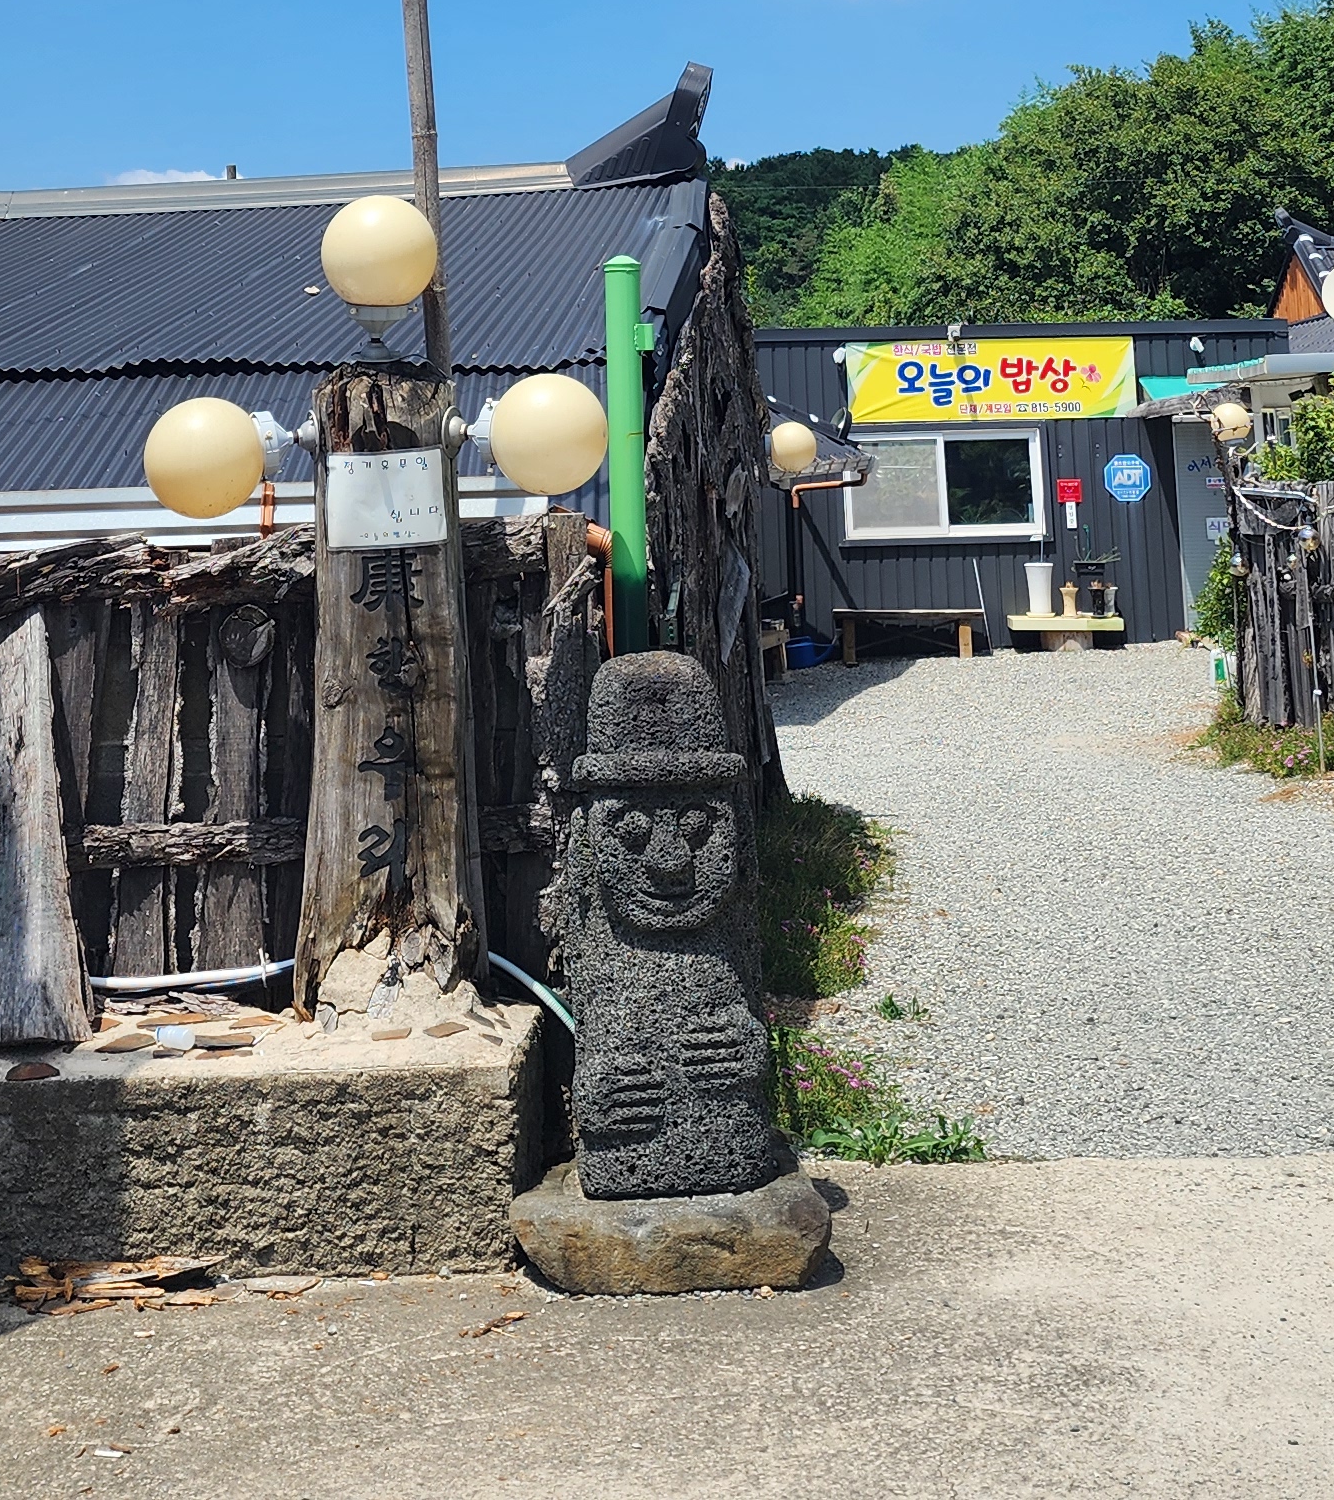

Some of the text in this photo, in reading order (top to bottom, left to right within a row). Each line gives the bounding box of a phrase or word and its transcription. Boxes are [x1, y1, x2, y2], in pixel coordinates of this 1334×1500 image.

[897, 357, 1077, 406] 오늘의 밥상
[1031, 402, 1081, 413] 815-5900
[1113, 469, 1142, 486] ADT
